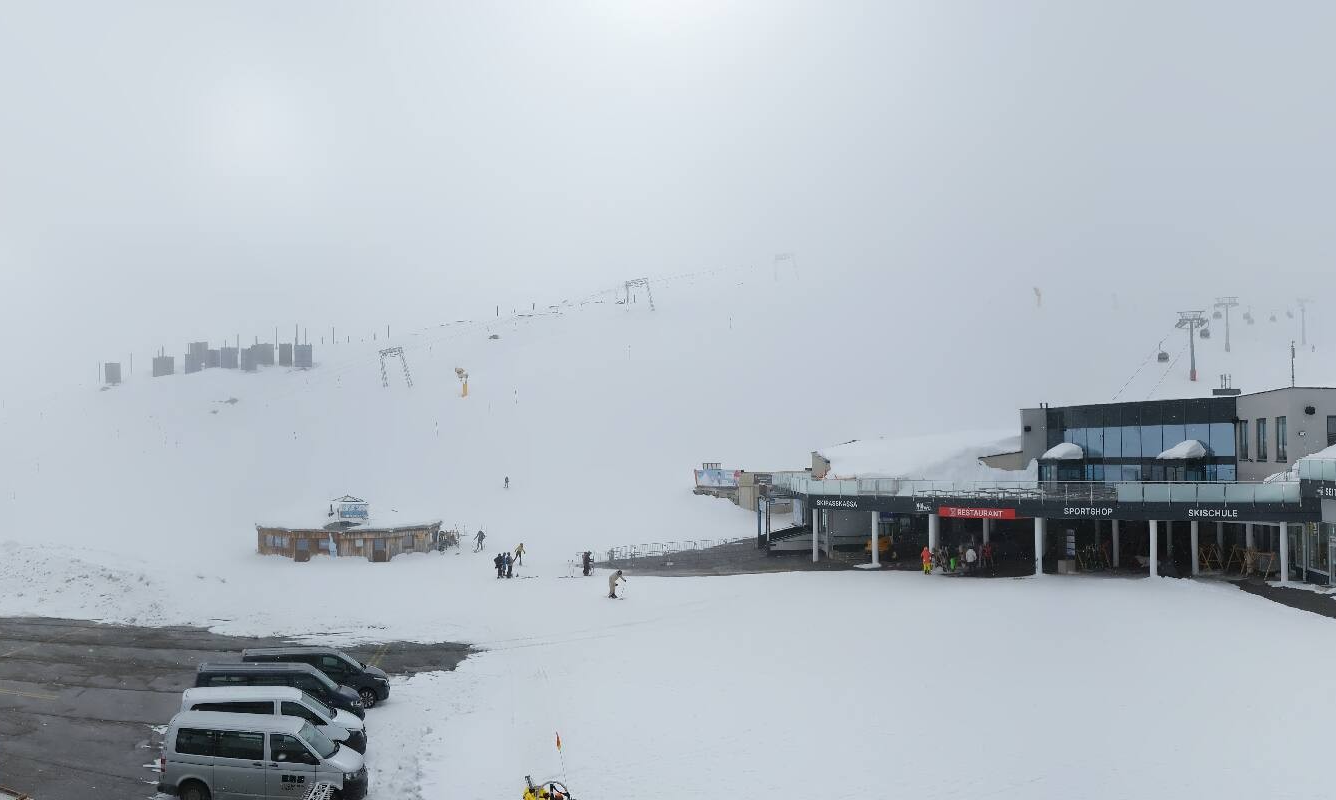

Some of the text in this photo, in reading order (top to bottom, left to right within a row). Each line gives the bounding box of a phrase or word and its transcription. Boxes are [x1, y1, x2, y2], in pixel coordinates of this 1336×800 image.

[957, 507, 1004, 518] RESTAURANT
[1063, 507, 1113, 517] SPORTSHOP
[1188, 509, 1238, 517] SKISCHULE
